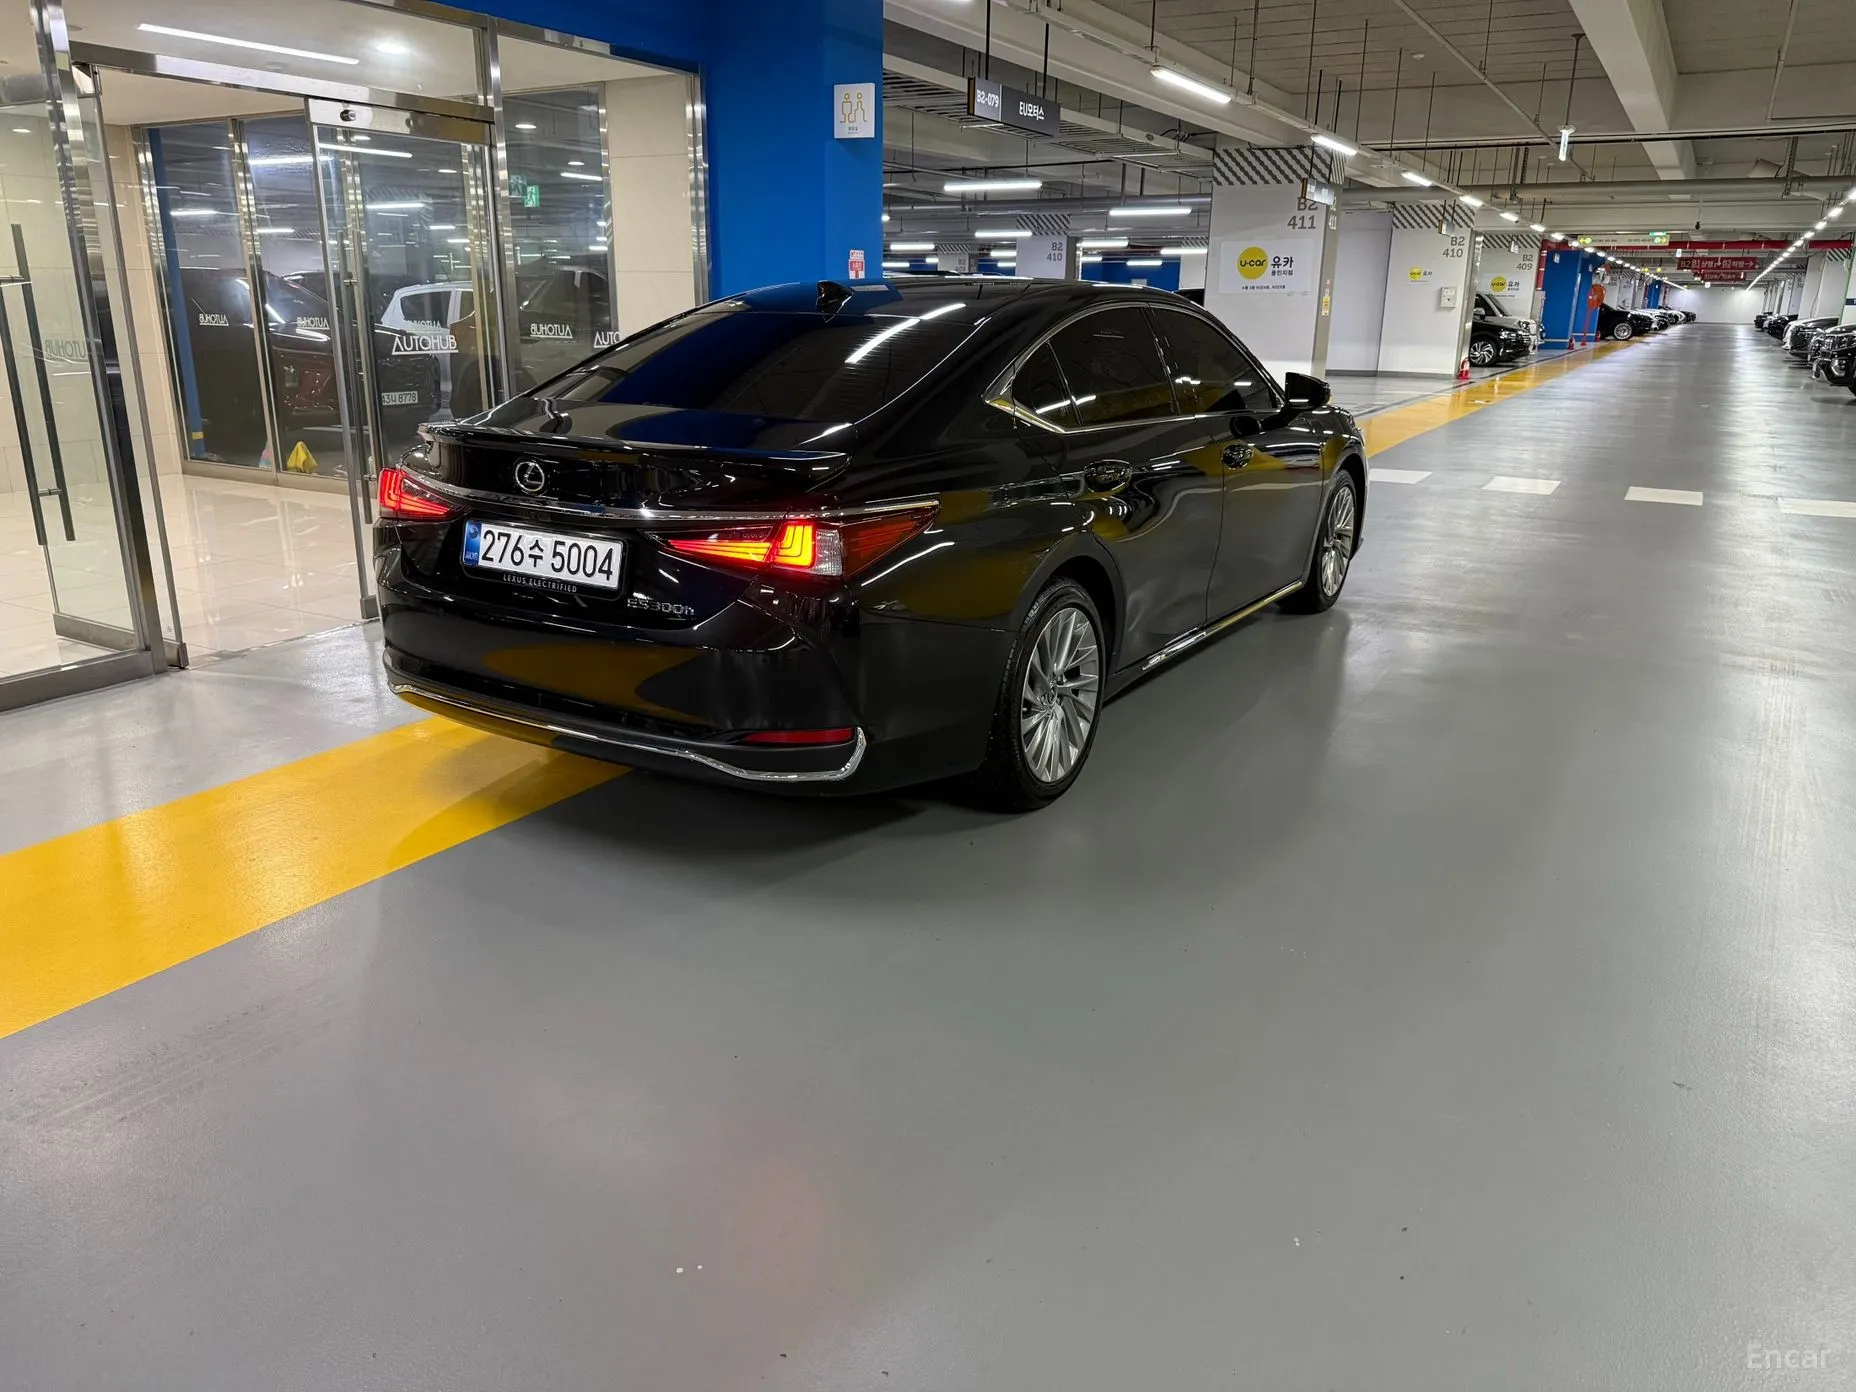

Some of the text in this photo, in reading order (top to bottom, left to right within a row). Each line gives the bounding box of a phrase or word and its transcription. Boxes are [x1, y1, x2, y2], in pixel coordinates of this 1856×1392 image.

[976, 89, 1045, 121] B2-079 EU모터스
[1287, 215, 1316, 230] 411
[1051, 242, 1063, 251] B2
[1450, 236, 1465, 246] B2
[1046, 253, 1063, 262] 410
[1442, 248, 1464, 258] 410
[1522, 254, 1534, 262] B2
[1271, 255, 1294, 269] 유카
[1516, 263, 1533, 271] 409
[392, 335, 459, 355] AUTOHUB
[398, 392, 417, 403] 8778
[481, 529, 614, 581] 276수 5004
[503, 573, 578, 594] LEXUS ELECTRIFIED
